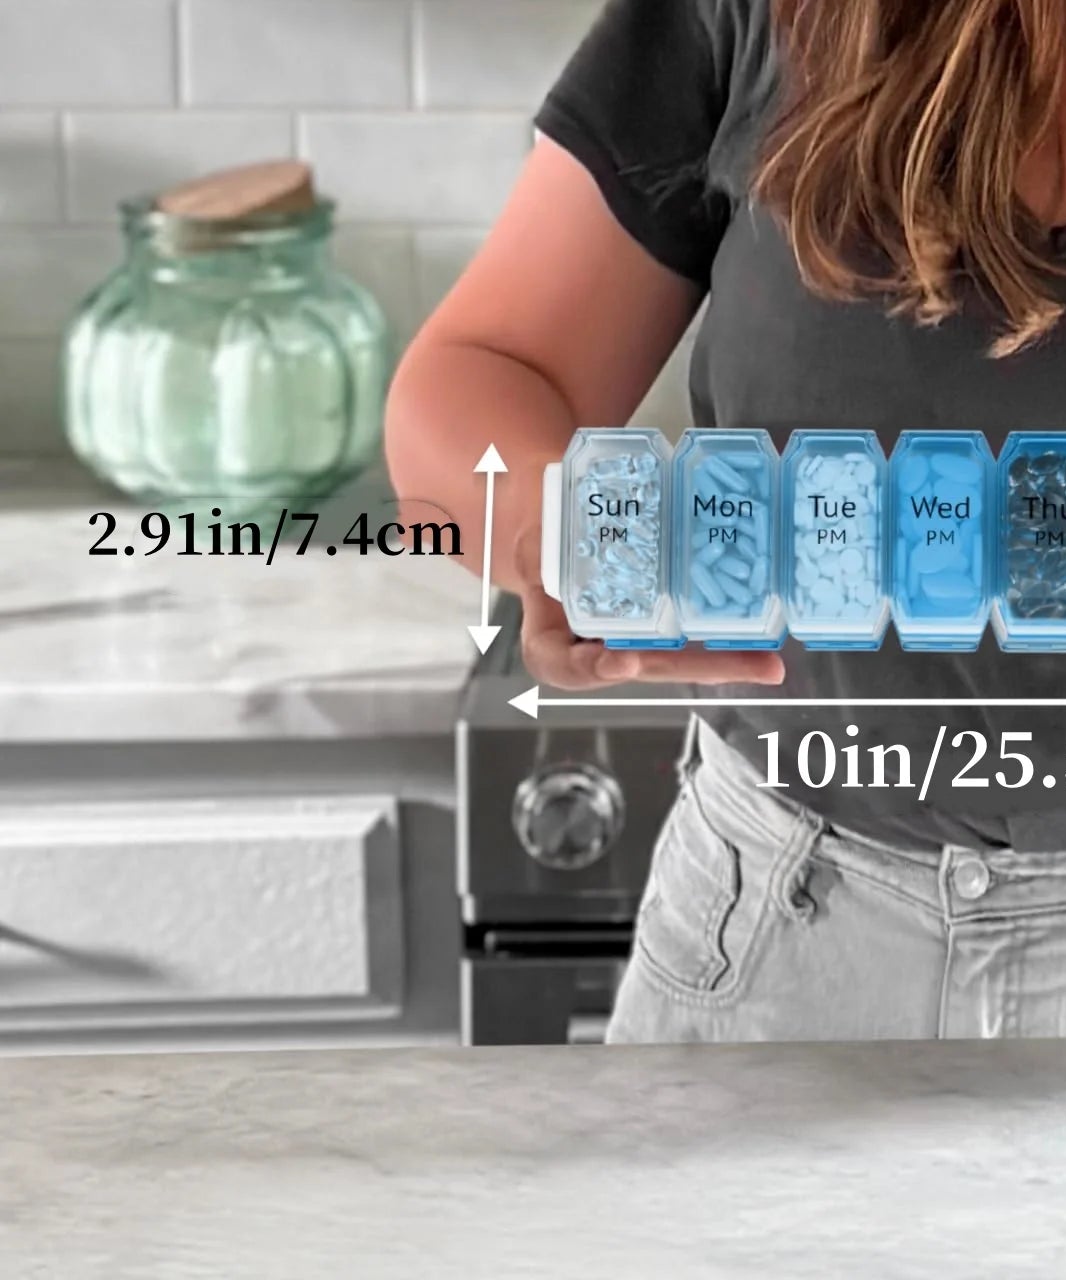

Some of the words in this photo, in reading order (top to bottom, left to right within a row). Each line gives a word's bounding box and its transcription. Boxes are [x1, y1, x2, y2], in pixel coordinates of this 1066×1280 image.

[587, 493, 641, 518] Sun
[693, 494, 754, 518] Mon
[807, 495, 857, 519] Tue
[910, 496, 971, 519] Wed
[599, 526, 629, 543] PM
[708, 528, 738, 544] PM
[817, 528, 847, 545] PM
[926, 530, 955, 546] PM
[1035, 531, 1065, 546] PM
